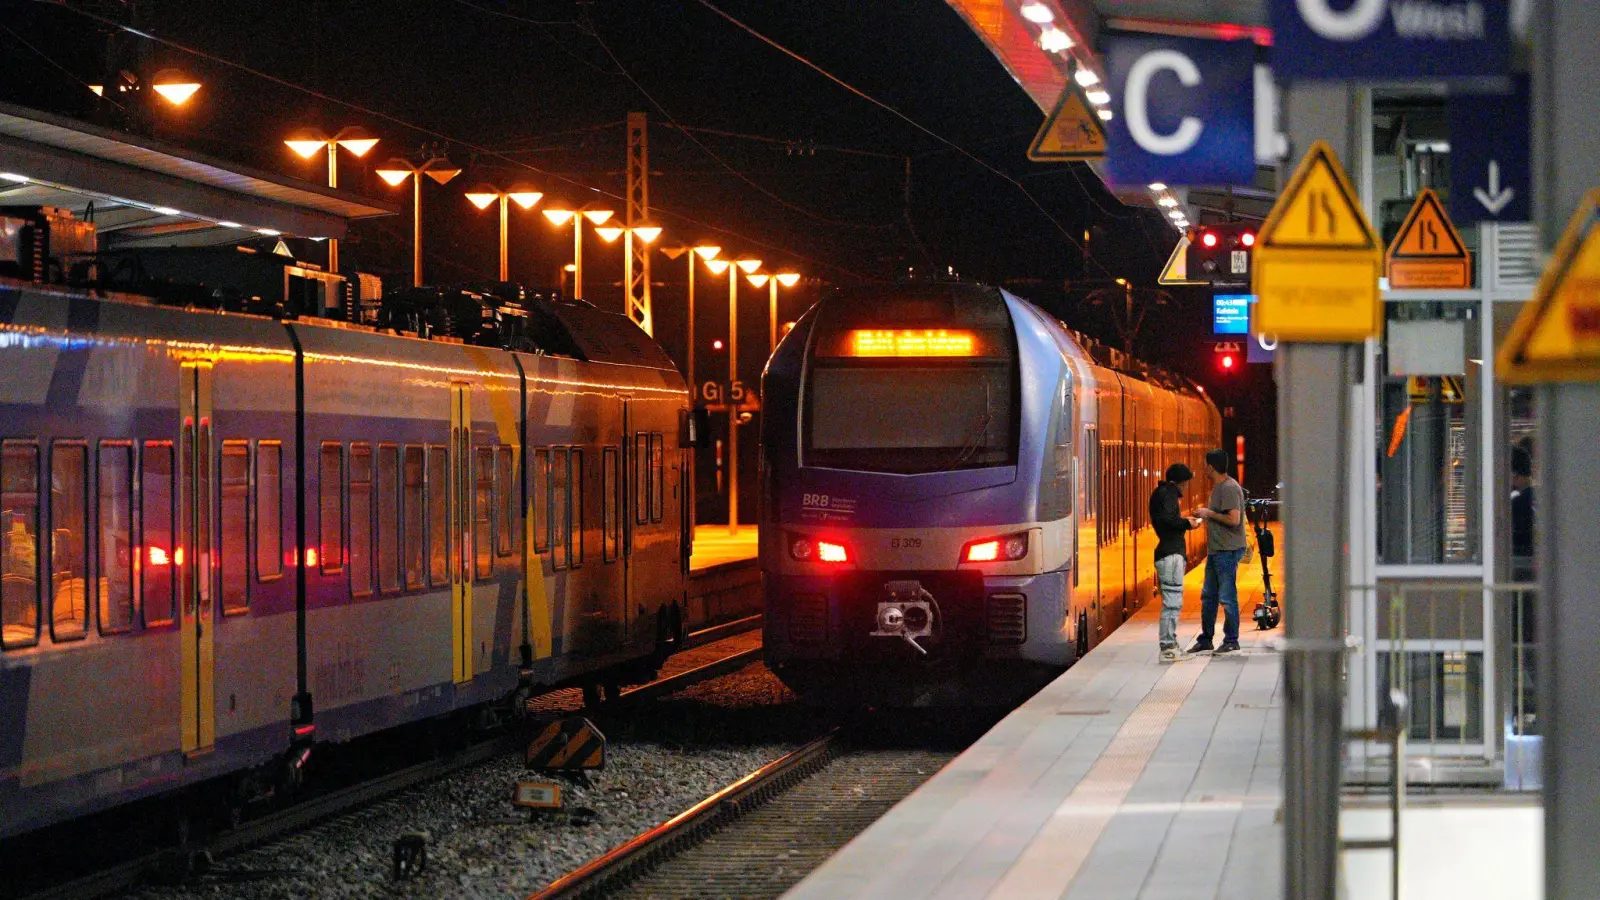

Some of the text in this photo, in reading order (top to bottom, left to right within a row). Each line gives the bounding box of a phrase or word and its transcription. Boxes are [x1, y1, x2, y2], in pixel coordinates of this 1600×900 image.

[1124, 49, 1203, 156] C
[731, 381, 744, 400] 5
[803, 493, 829, 507] BRB
